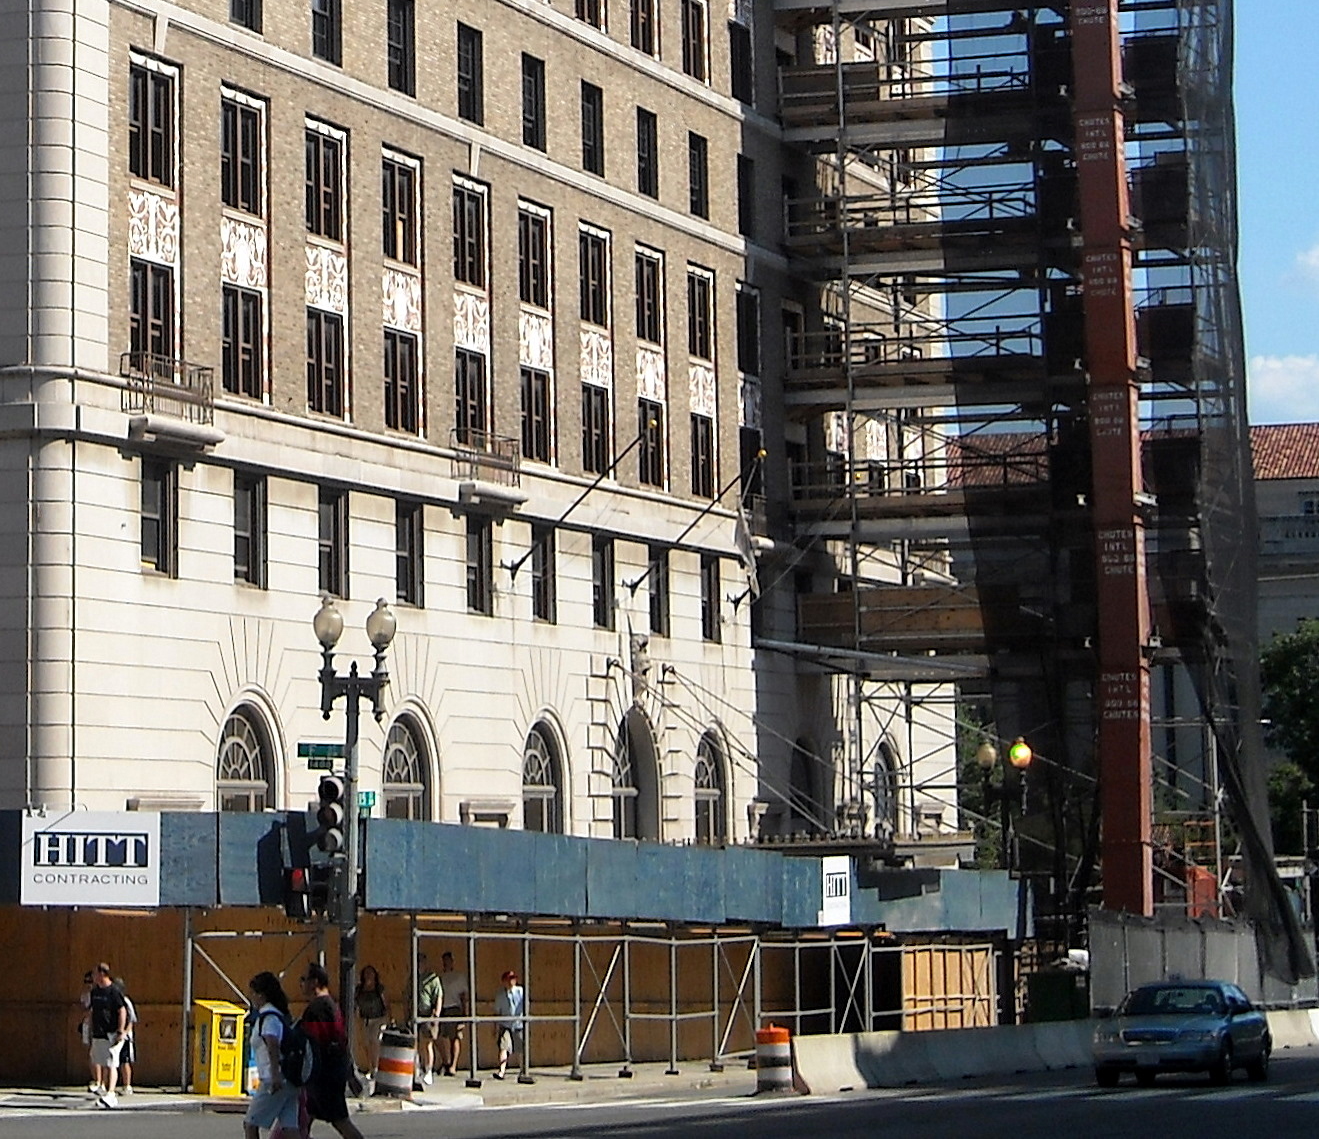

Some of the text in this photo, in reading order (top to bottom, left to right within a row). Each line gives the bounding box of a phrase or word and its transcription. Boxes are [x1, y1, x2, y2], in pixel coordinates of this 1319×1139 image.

[36, 834, 146, 867] HITT
[33, 873, 148, 885] CONTRACTING
[826, 873, 847, 897] HITT
